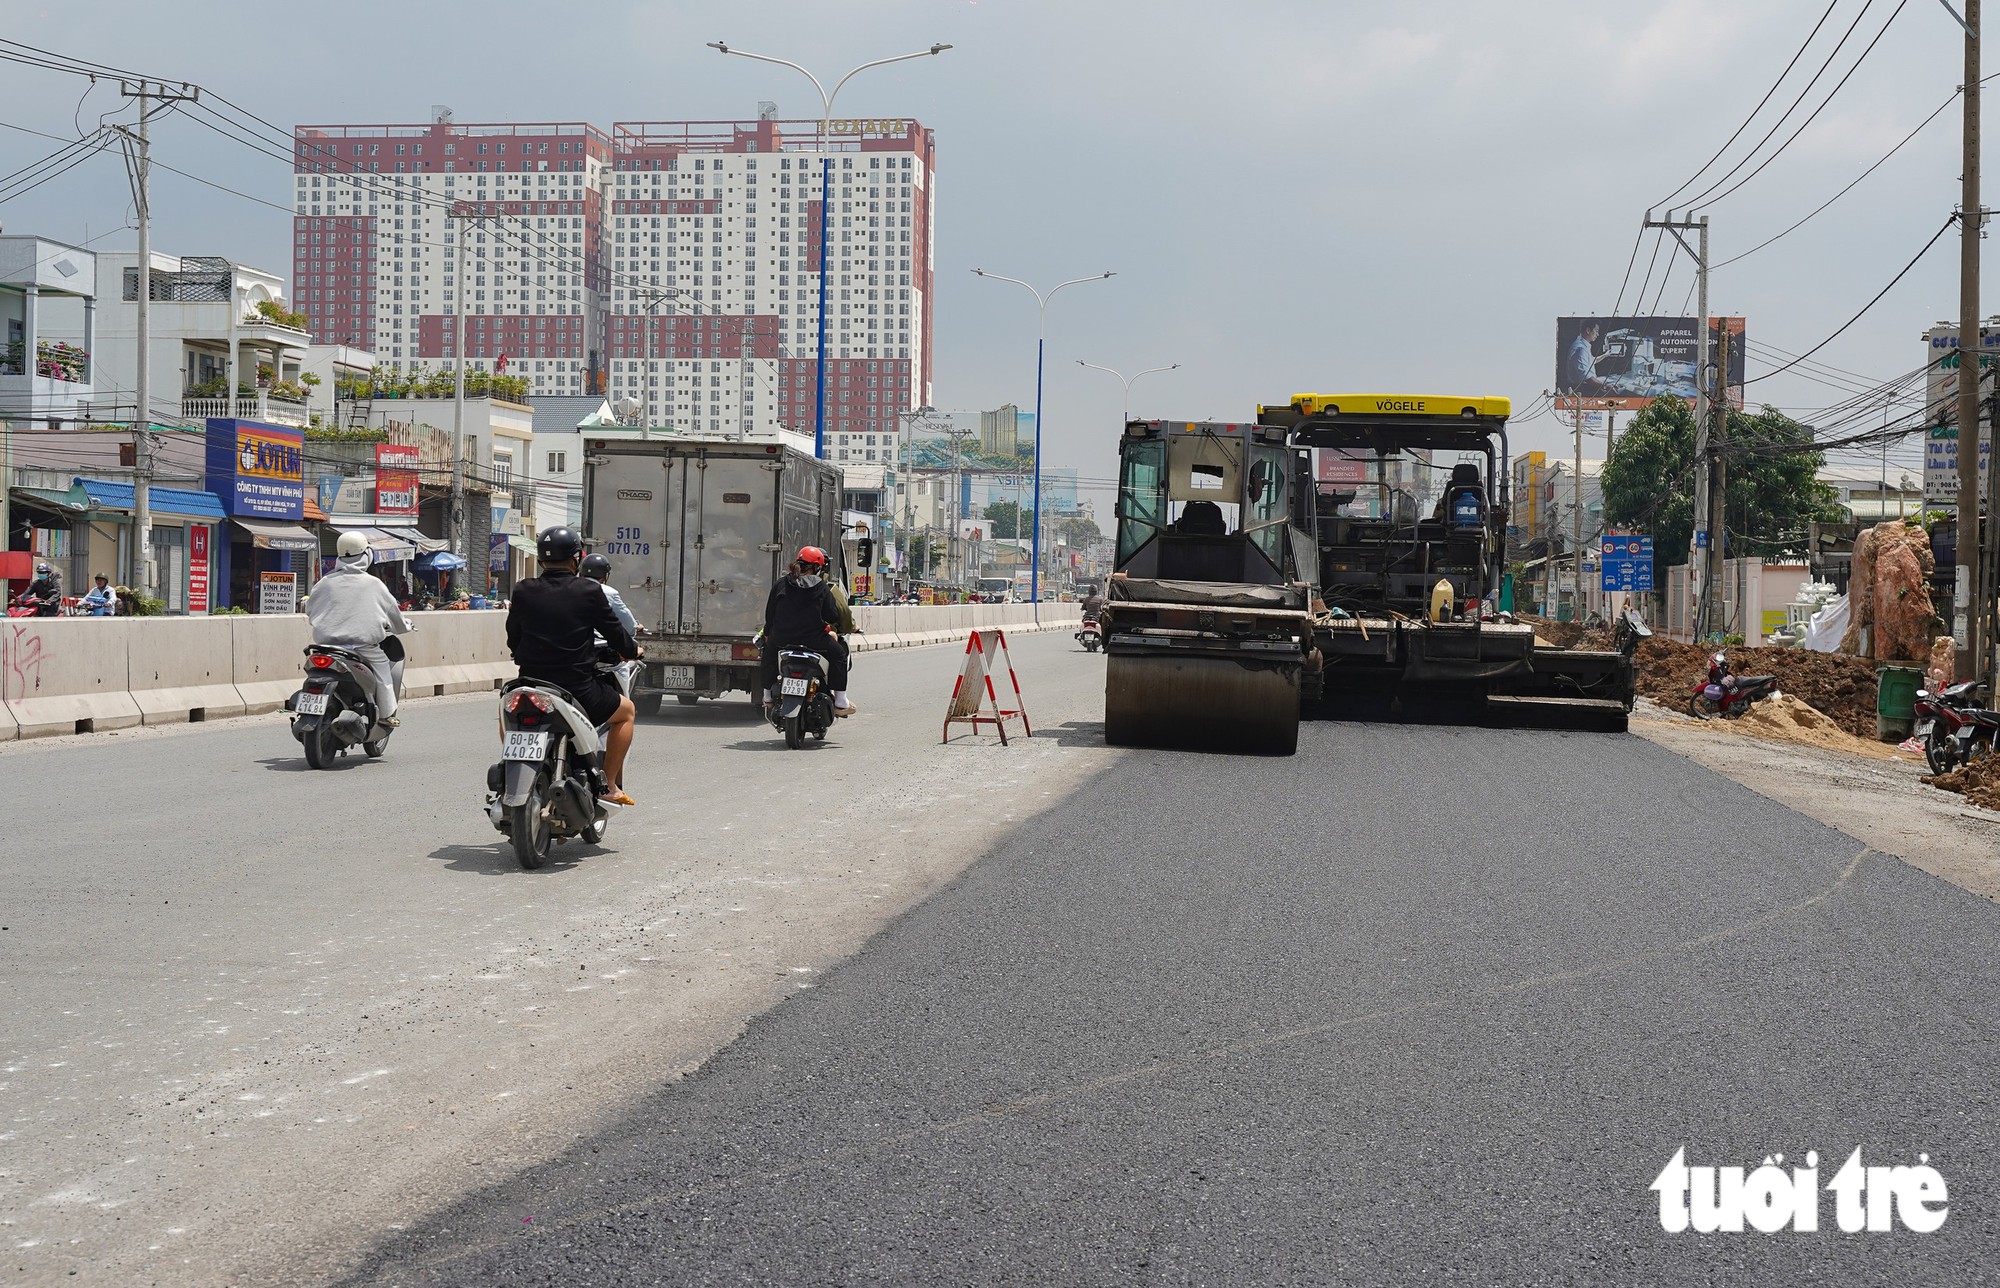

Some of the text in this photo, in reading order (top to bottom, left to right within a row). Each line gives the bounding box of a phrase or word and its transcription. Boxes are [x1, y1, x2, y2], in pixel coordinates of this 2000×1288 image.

[1376, 398, 1425, 411] VÖGELE
[255, 441, 301, 475] JOTUN
[236, 480, 251, 493] CÔNG
[252, 484, 259, 494] TY
[293, 488, 302, 498] PHÚ
[619, 491, 650, 499] THACO
[616, 527, 641, 540] 51D
[607, 543, 650, 555] 070.78
[269, 575, 293, 583] JOTUN
[262, 583, 293, 592] VĨNH PHÚ
[671, 667, 688, 677] 51D
[298, 703, 323, 713] 414.84
[510, 734, 540, 746] 60-B4
[504, 747, 543, 759] 440.20
